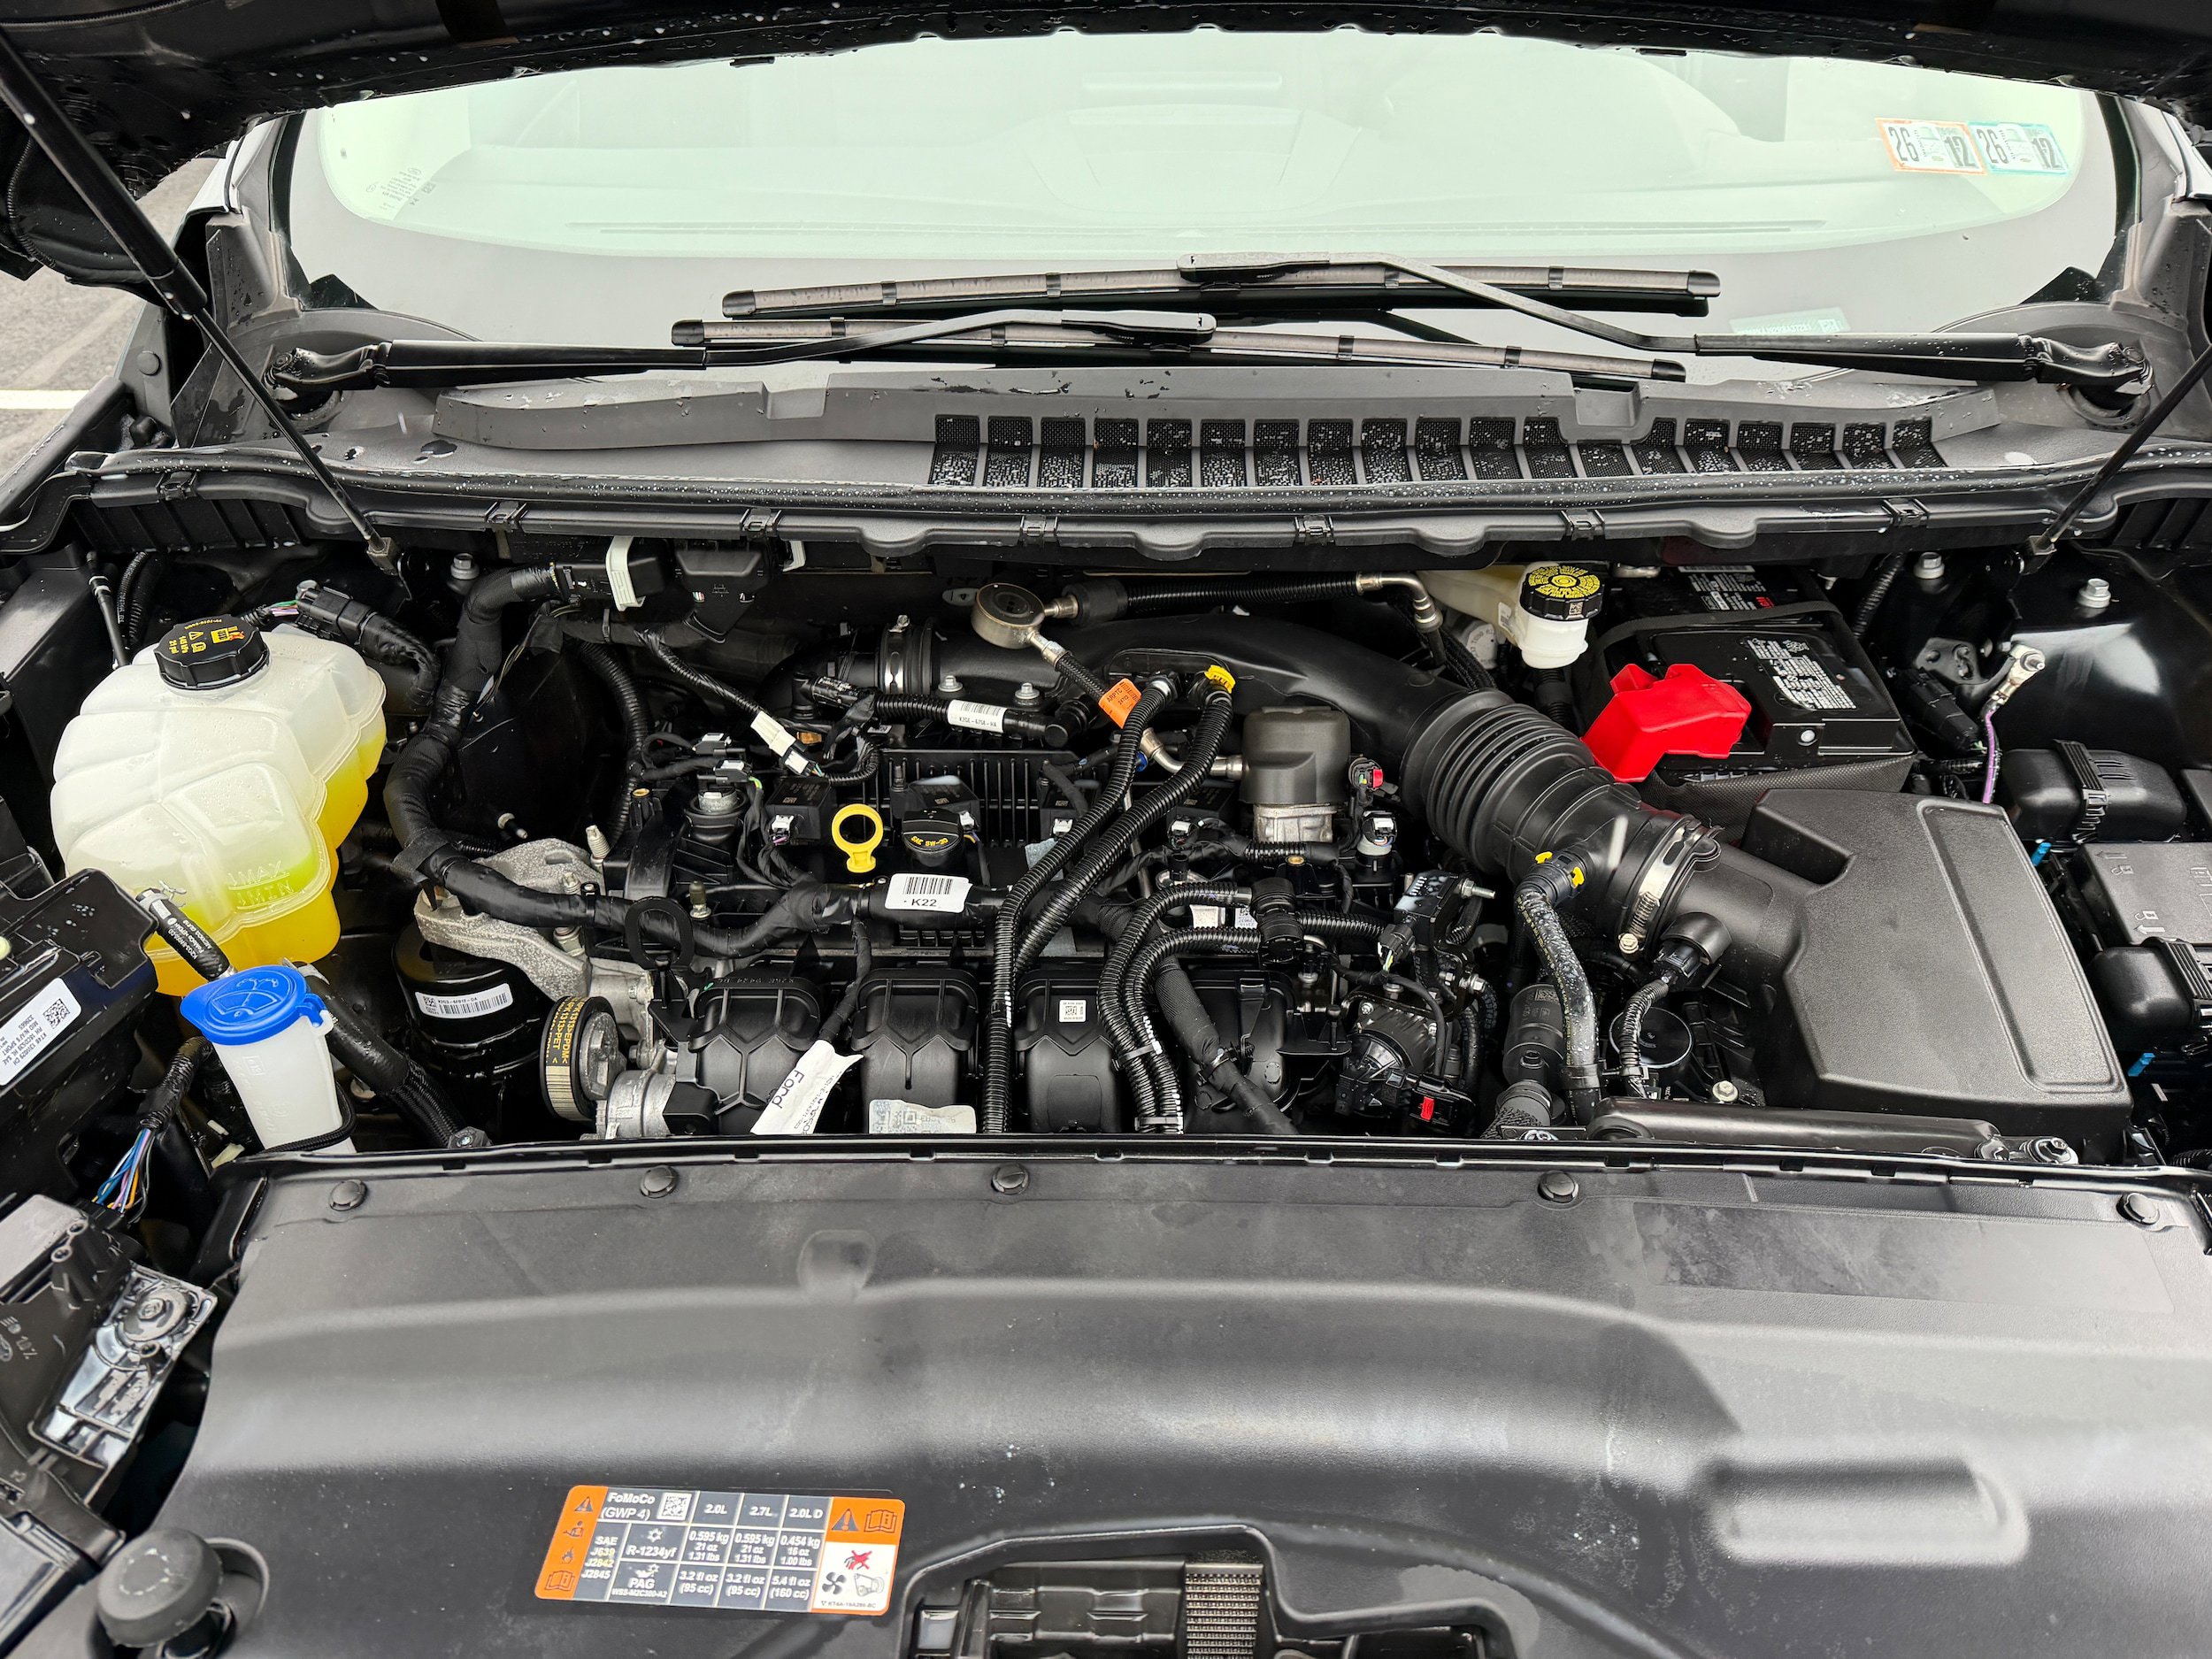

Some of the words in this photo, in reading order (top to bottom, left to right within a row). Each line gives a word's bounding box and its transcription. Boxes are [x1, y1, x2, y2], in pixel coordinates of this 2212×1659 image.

[1888, 127, 1920, 162] 26
[1978, 128, 2008, 164] 26
[1944, 135, 1978, 167] 12
[2032, 137, 2062, 168] 12
[911, 835, 924, 845] SAE
[925, 838, 949, 847] 5W-30
[237, 860, 281, 885] MAX
[246, 879, 295, 904] MIN
[911, 898, 937, 907] K22
[35, 1026, 42, 1035] RH
[2, 1041, 17, 1056] SPORT
[3, 1056, 12, 1065] SAE
[772, 1071, 804, 1109] Ford
[608, 1492, 655, 1505] FoMoCo
[600, 1507, 637, 1519] (GWP
[637, 1508, 650, 1521] 4)
[704, 1504, 727, 1515] 2.0L
[749, 1506, 772, 1517] 2.7L
[789, 1508, 812, 1518] 2.0L
[813, 1509, 824, 1518] D
[595, 1535, 618, 1546] SAE
[689, 1530, 716, 1541] 0.595
[717, 1532, 730, 1545] kg
[734, 1532, 762, 1544] 0.595
[762, 1534, 775, 1547] kg
[780, 1535, 807, 1547] 0.454
[807, 1538, 821, 1549] kg
[590, 1548, 616, 1557] J639
[626, 1545, 678, 1559] R-1234yf
[695, 1542, 706, 1551] 21
[741, 1545, 752, 1554] 21
[585, 1557, 615, 1568] J2842
[688, 1551, 706, 1561] 1.31
[707, 1553, 720, 1563] lbs
[734, 1554, 752, 1563] 1.31
[753, 1555, 766, 1564] lbs
[780, 1556, 798, 1565] 1.00
[799, 1558, 812, 1567] lbs
[581, 1569, 611, 1579] J2845
[679, 1571, 695, 1580] 3.2
[696, 1571, 706, 1581] fl
[706, 1574, 719, 1583] oz
[726, 1573, 742, 1583] 3.2
[743, 1574, 752, 1583] fl
[628, 1578, 656, 1590] PAG
[772, 1576, 788, 1586] 5.4
[789, 1577, 797, 1586] fl
[798, 1578, 811, 1587] oz
[680, 1582, 696, 1594] (95
[696, 1584, 714, 1595] cc)
[727, 1585, 743, 1597] (95
[744, 1586, 761, 1598] cc)
[770, 1587, 792, 1600] (160
[793, 1588, 810, 1601] cc)
